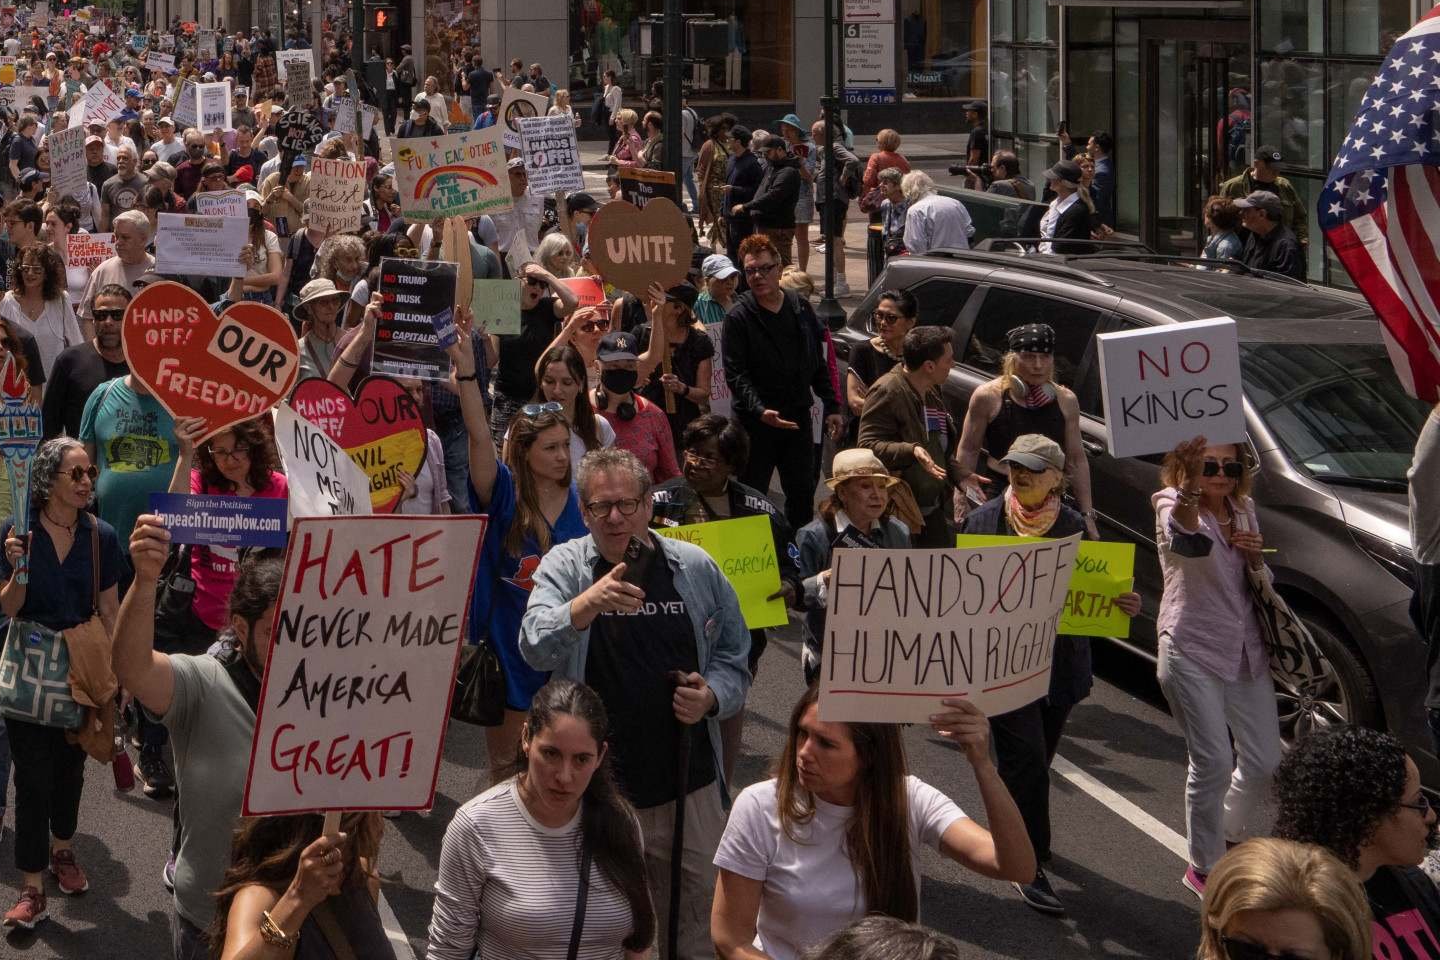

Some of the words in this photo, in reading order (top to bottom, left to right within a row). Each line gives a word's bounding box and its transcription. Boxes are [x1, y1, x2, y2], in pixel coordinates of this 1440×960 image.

[847, 24, 857, 37] 6
[913, 71, 943, 84] Stuart
[52, 129, 80, 146] HAPPY
[279, 113, 323, 143] SCIENCE
[288, 127, 304, 139] NOT
[530, 138, 569, 151] HANDS
[312, 159, 365, 179] ACTION
[407, 152, 439, 171] FUCK
[533, 151, 573, 167] OFF!
[437, 184, 461, 197] THE
[637, 181, 653, 194] The
[431, 189, 478, 210] PLANET
[67, 242, 106, 251] FAMILIES
[68, 235, 91, 243] KEEP
[68, 247, 113, 257] TOGETHER
[605, 235, 676, 265] UNITE
[383, 273, 397, 284] NO
[397, 274, 428, 286] TRUMP
[382, 292, 395, 303] NO
[396, 294, 421, 304] MUSK
[145, 327, 193, 346] OFF!
[377, 328, 391, 339] NO
[132, 306, 201, 325] HANDS
[217, 324, 287, 382] OUR
[1138, 341, 1210, 381] NO
[155, 357, 268, 414] FREEDOM
[295, 396, 347, 417] HANDS
[361, 394, 418, 425] OUR
[1121, 384, 1229, 427] KINGS
[294, 420, 338, 477] NOT
[316, 471, 355, 514] MEIN
[186, 498, 206, 509] Sign
[205, 499, 220, 509] the
[220, 500, 253, 510] Petition:
[154, 508, 281, 532] ImpeachTrumpNow.com
[291, 528, 444, 600] HATE
[722, 543, 776, 576] GARCÍA
[833, 553, 985, 618] HANDS
[988, 541, 1073, 615] OFF
[659, 600, 685, 615] YET
[1063, 591, 1115, 618] ARTH
[276, 604, 373, 649] NEVER
[383, 611, 459, 648] MADE
[829, 628, 973, 686] HUMAN
[277, 657, 412, 718] AMERICA
[270, 722, 414, 795] GREAT!
